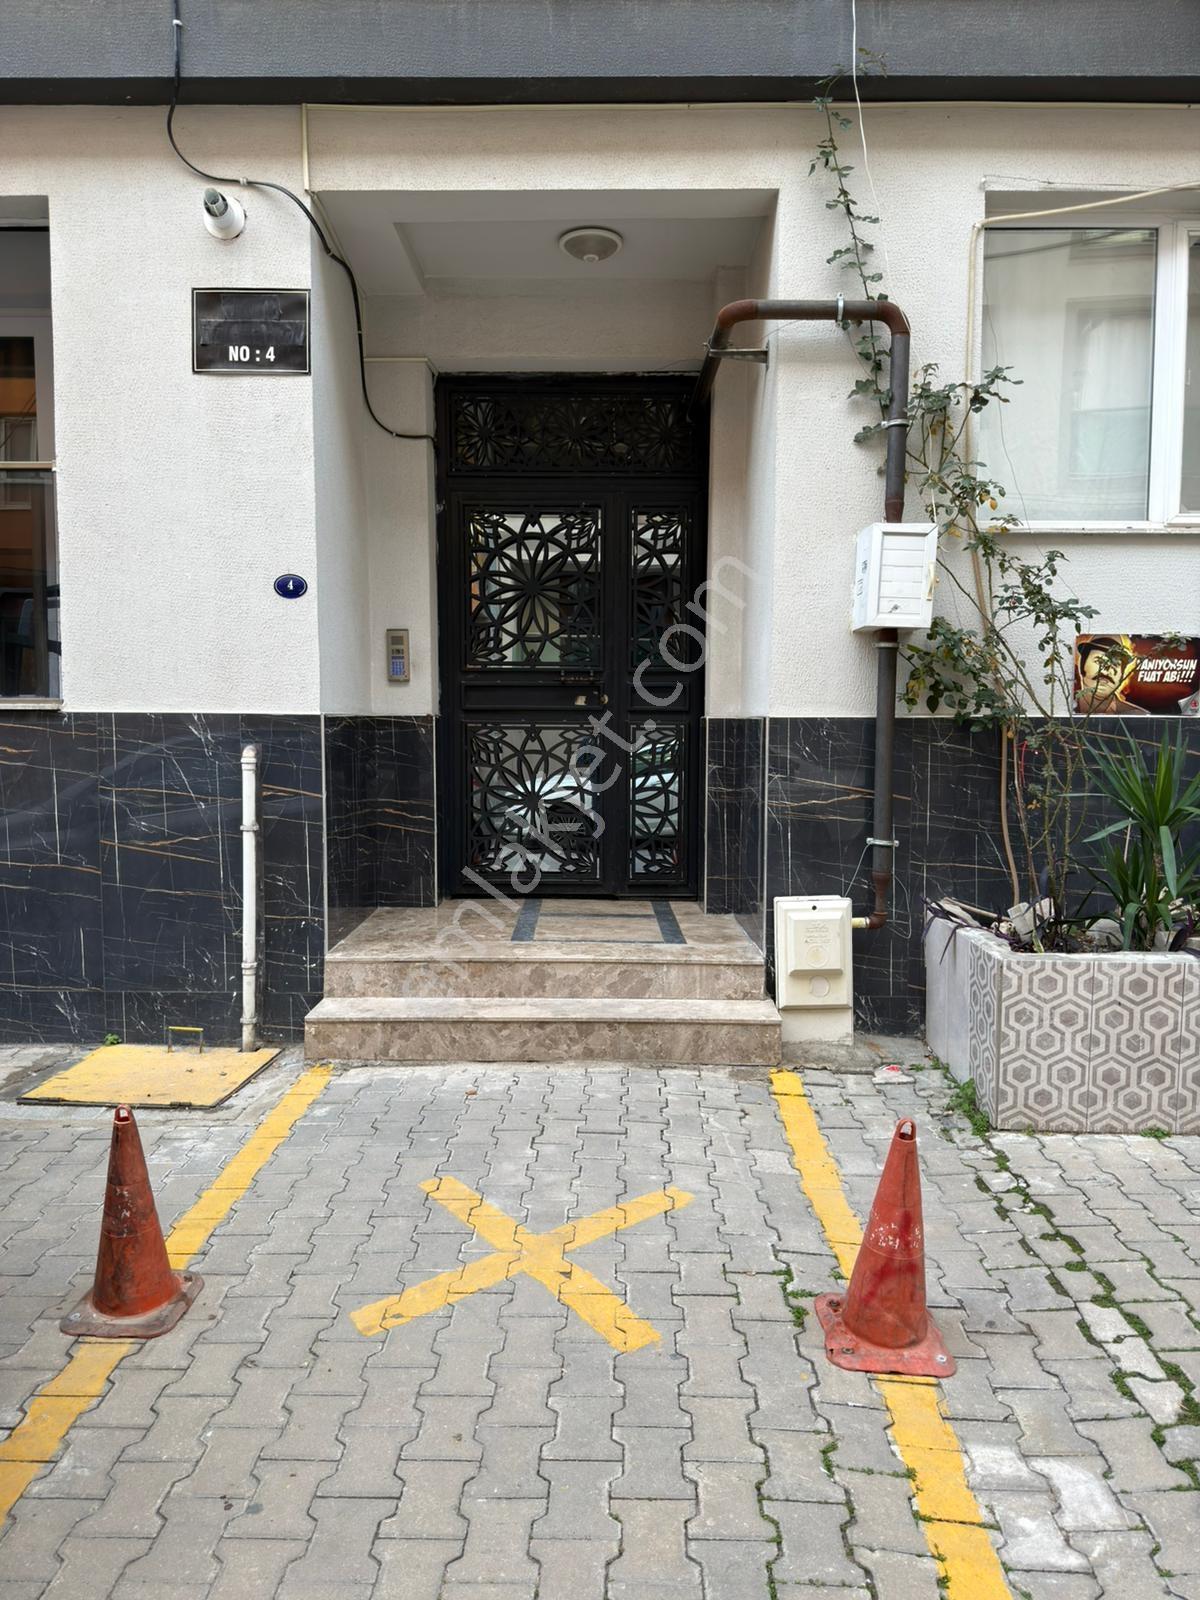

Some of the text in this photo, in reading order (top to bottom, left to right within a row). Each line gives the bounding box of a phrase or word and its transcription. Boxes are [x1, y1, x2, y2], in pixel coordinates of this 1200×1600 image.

[228, 345, 250, 362] NO
[265, 346, 276, 362] 4
[287, 579, 293, 590] 4
[1137, 671, 1163, 683] FUAT
